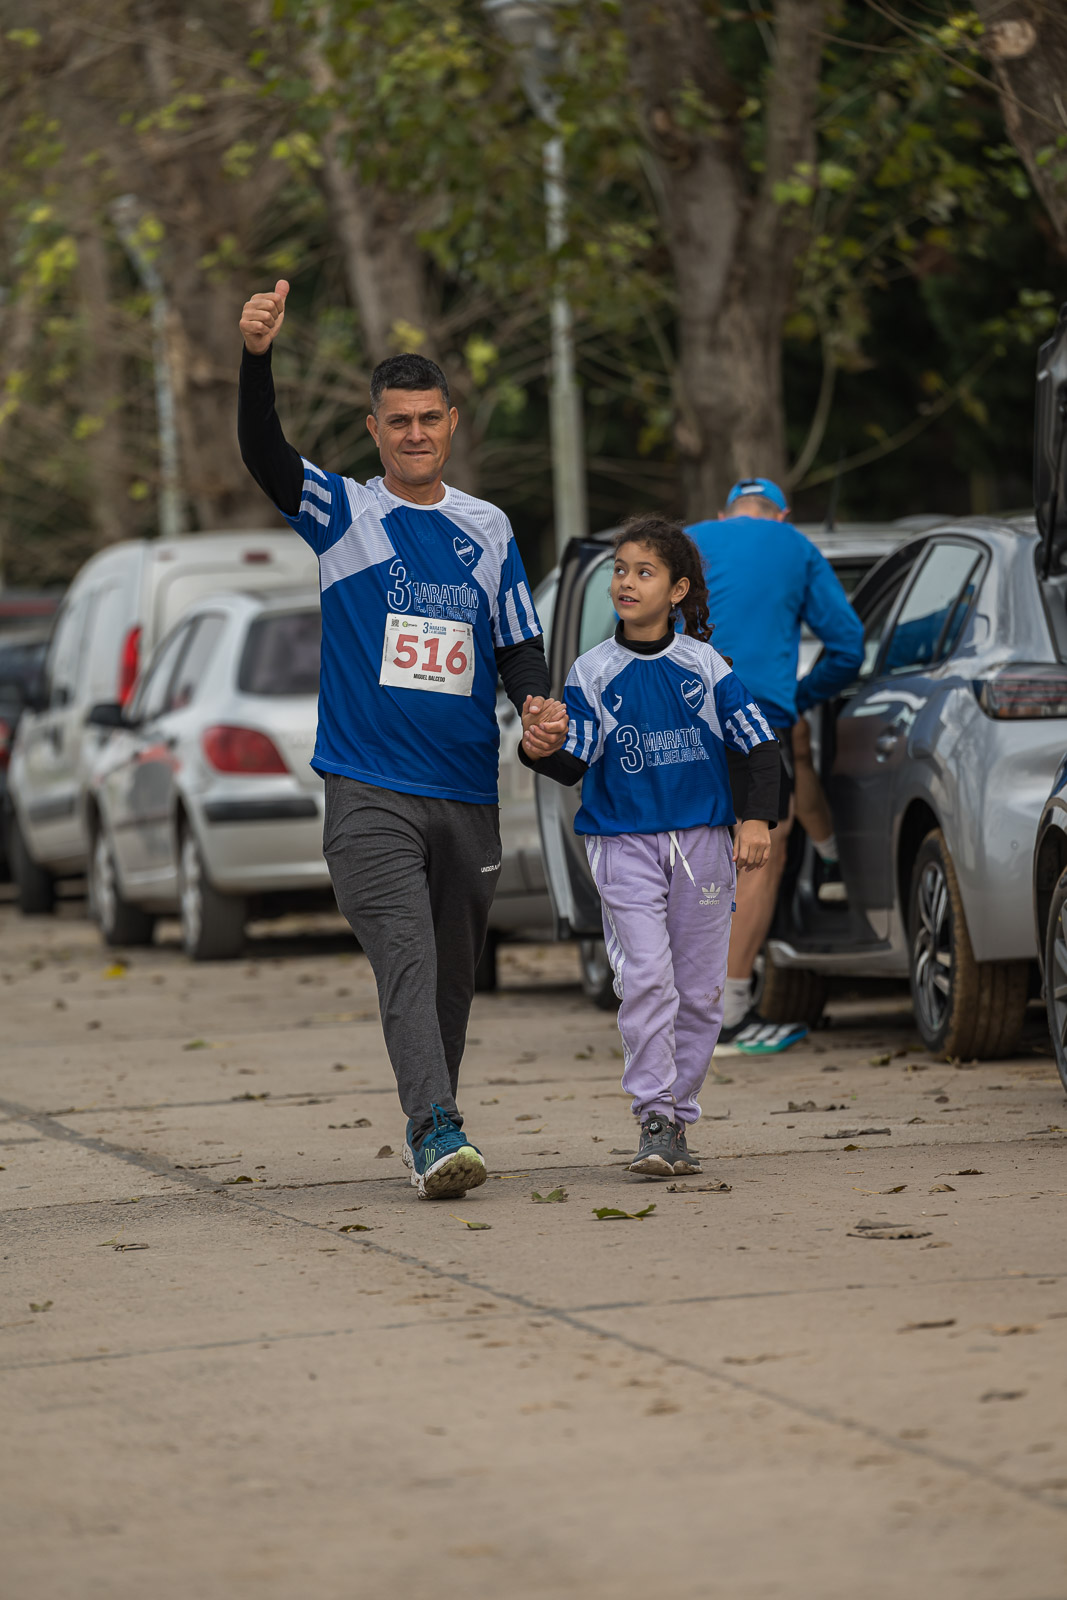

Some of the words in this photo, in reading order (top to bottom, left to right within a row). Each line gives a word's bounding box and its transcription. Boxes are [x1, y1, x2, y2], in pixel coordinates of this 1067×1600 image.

[387, 559, 411, 612] 3
[423, 622, 429, 634] 3
[393, 634, 467, 675] 516
[616, 725, 643, 773] 3
